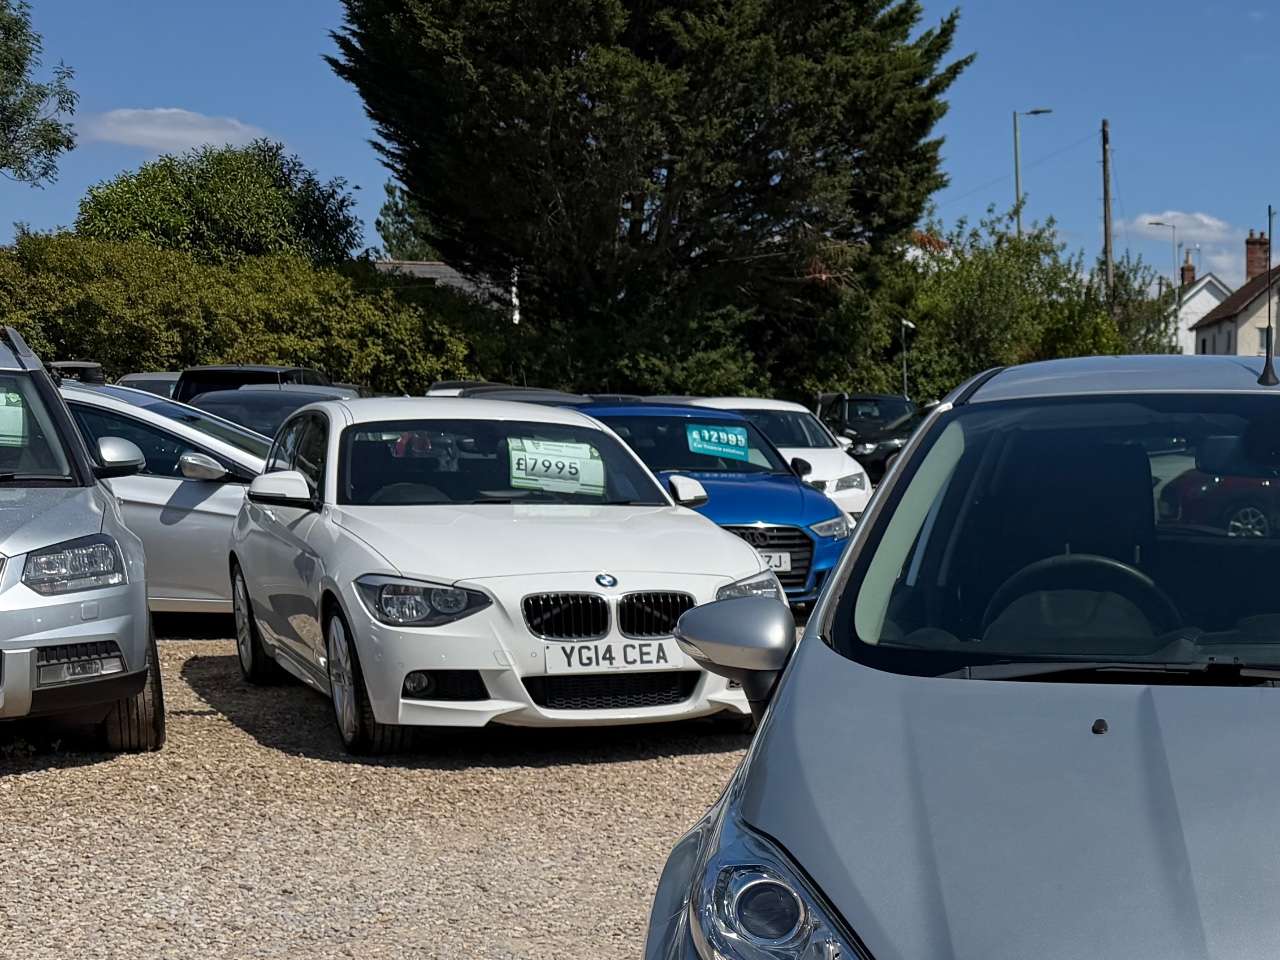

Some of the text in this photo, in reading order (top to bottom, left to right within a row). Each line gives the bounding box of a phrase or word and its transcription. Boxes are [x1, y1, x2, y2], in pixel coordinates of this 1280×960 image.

[515, 457, 580, 476] £7995
[561, 642, 669, 667] YG14 CEA
